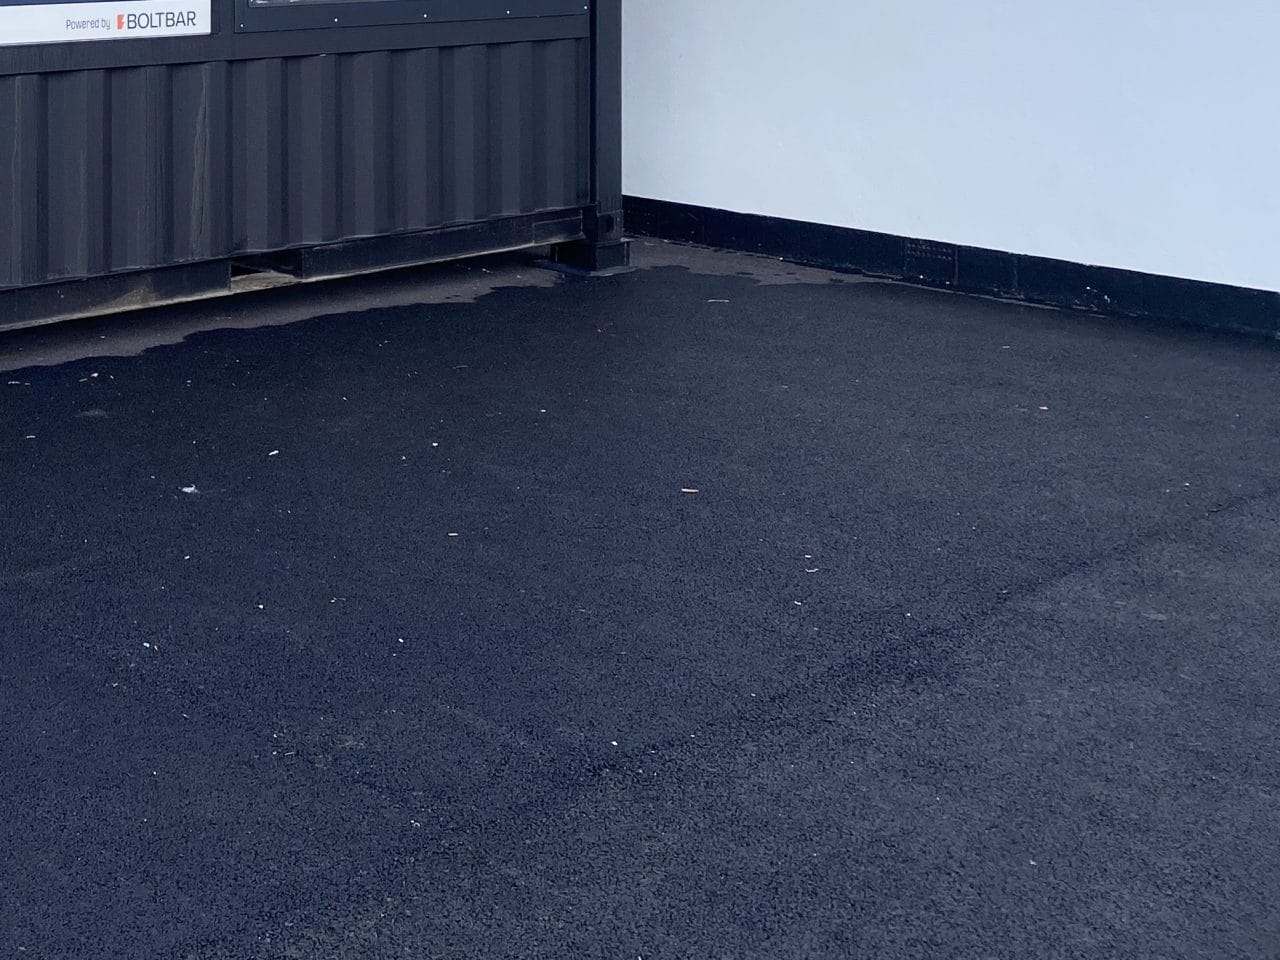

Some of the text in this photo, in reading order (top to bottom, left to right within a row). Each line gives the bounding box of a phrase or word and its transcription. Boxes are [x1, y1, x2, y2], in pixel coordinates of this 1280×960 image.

[66, 11, 196, 30] Powered by BOLTBAR
